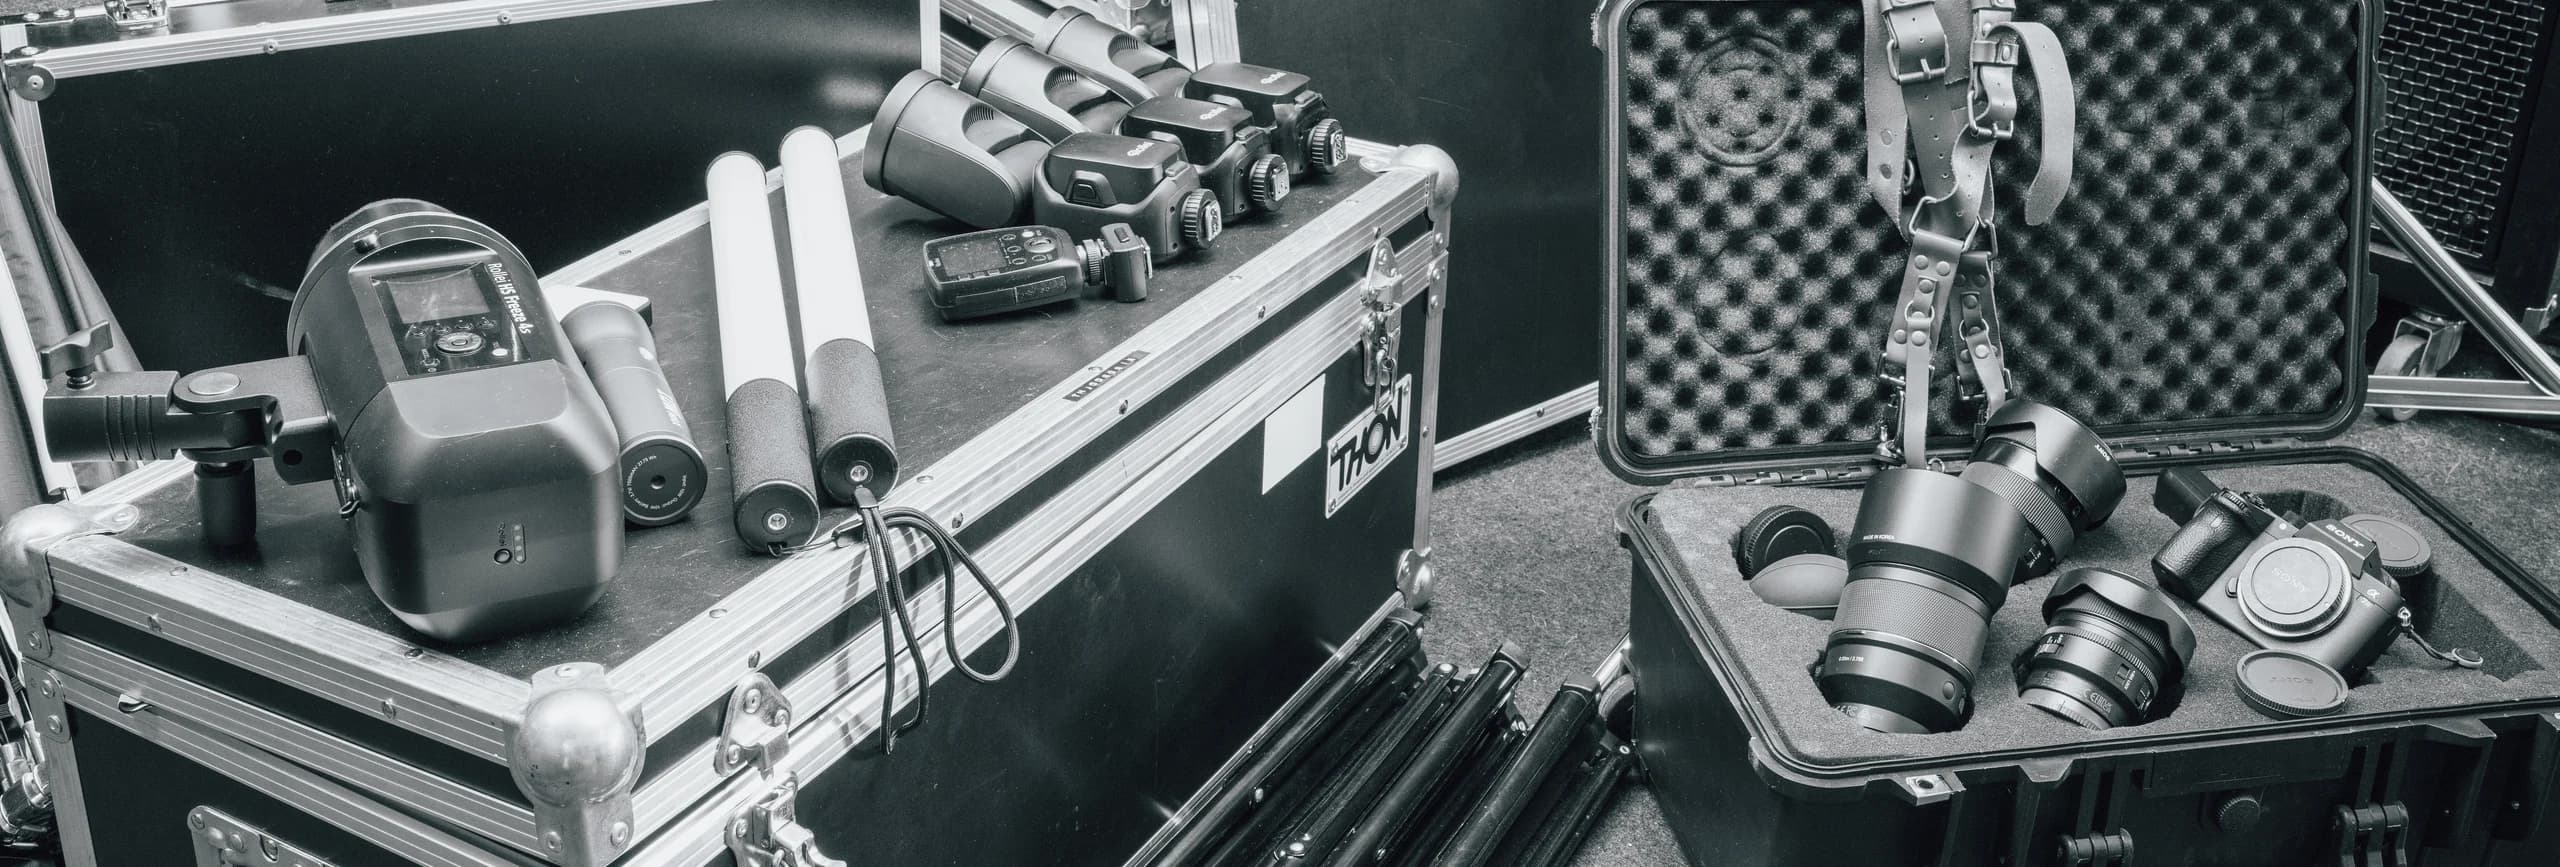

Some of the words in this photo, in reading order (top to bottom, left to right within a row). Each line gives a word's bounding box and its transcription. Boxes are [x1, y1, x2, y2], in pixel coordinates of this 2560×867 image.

[487, 262, 511, 283] Rollei
[497, 283, 517, 295] HS
[504, 295, 527, 322] Freeze
[518, 322, 534, 334] 4s
[1331, 387, 1403, 491] THON
[2094, 443, 2111, 462] SONY
[2325, 523, 2365, 548] SONY
[2271, 566, 2307, 594] SONY
